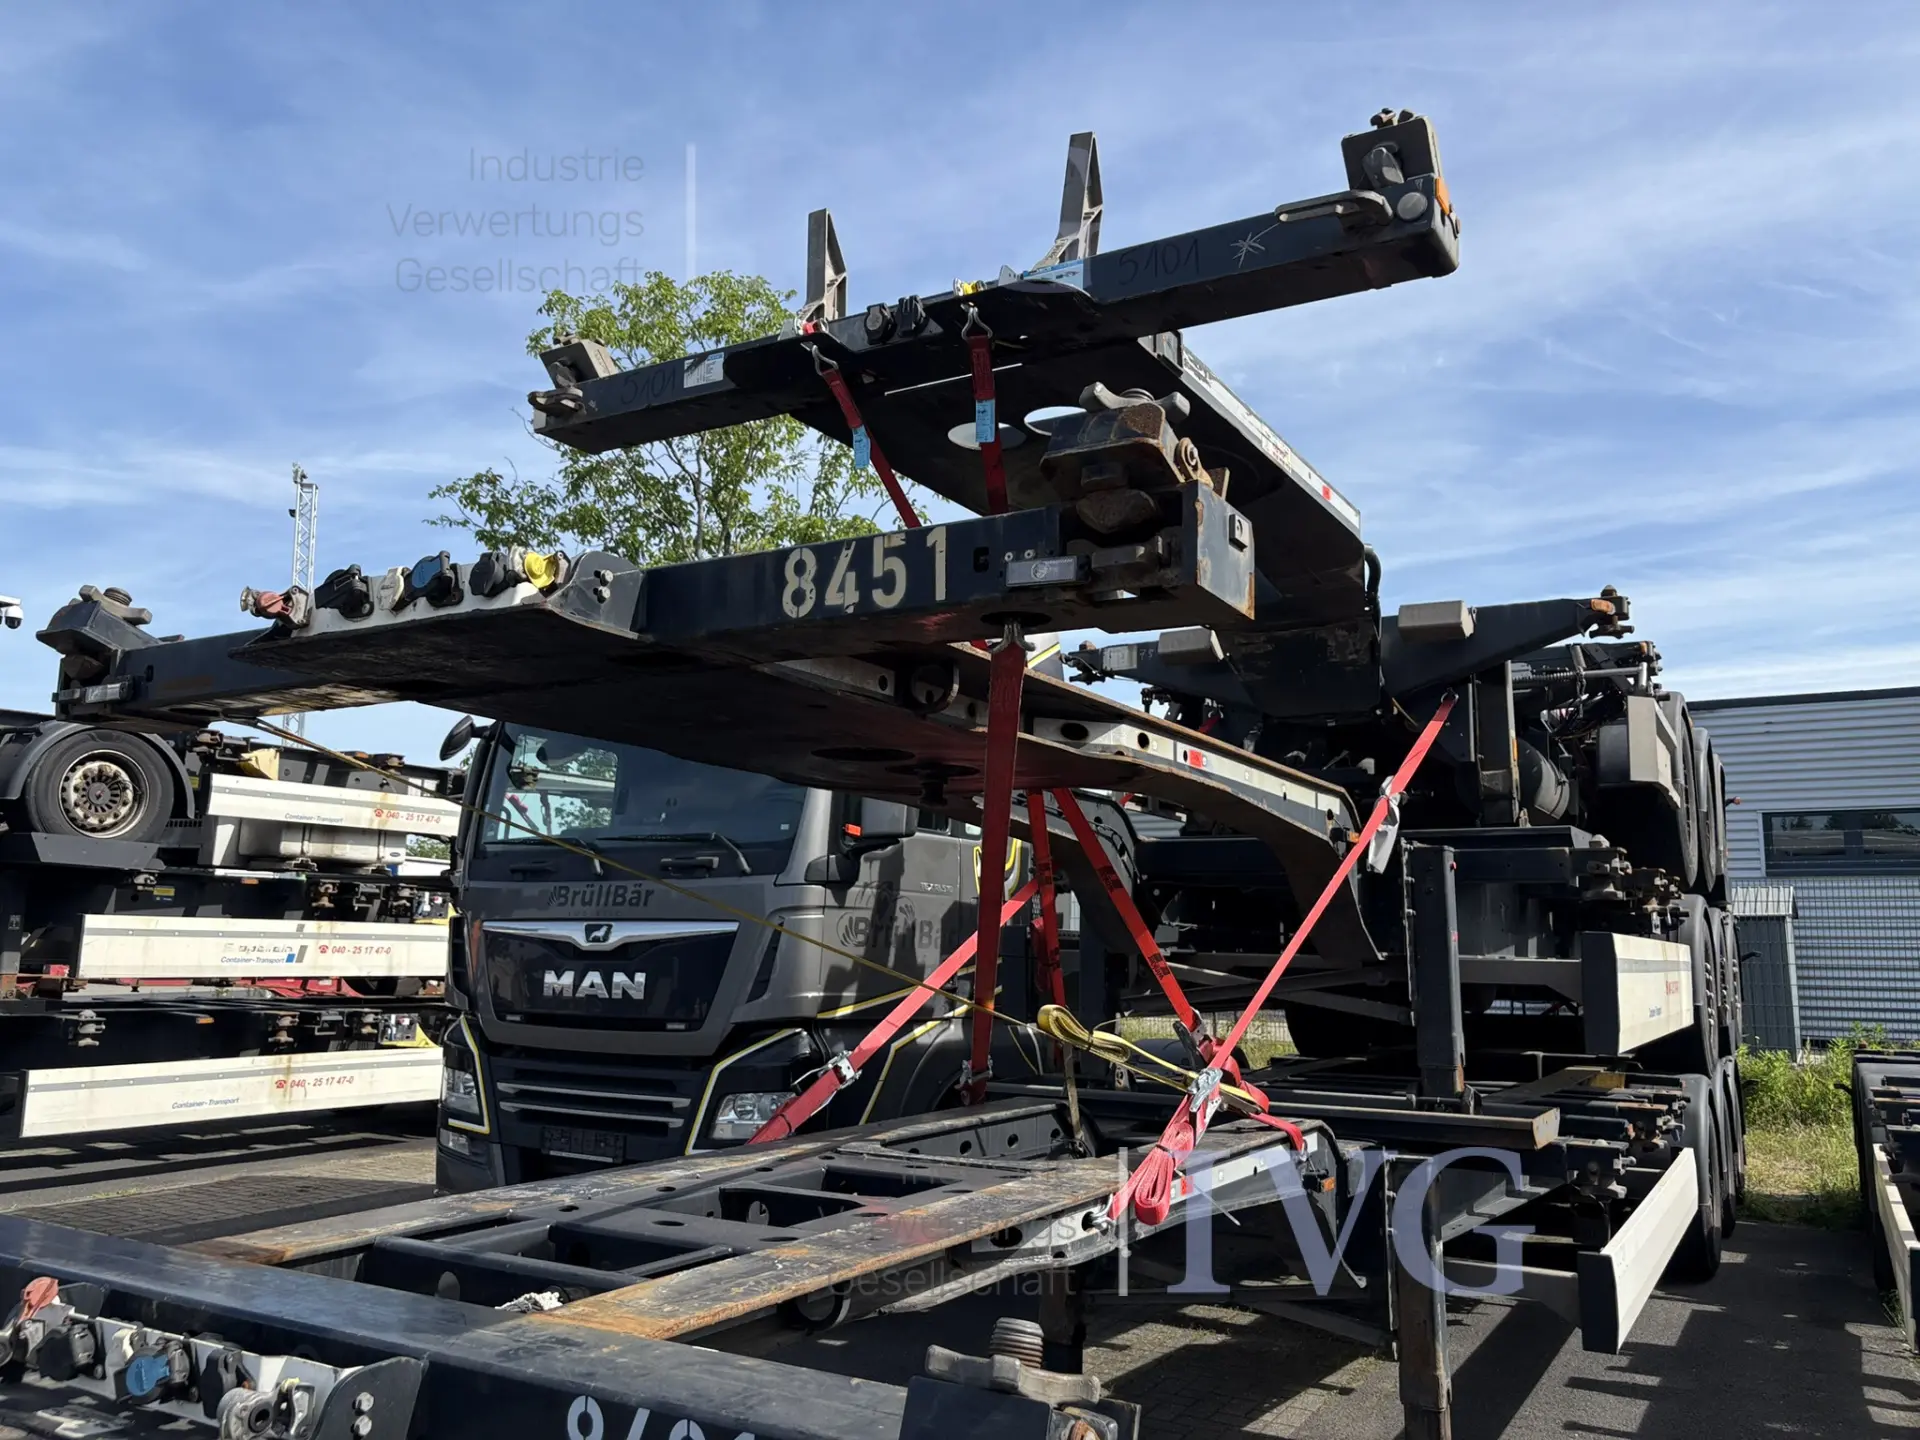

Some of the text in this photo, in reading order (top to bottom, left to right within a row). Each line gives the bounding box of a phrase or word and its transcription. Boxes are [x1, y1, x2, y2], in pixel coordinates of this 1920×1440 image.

[1118, 238, 1200, 286] 5101
[782, 525, 947, 619] 8451
[284, 812, 344, 824] Container-Transport
[386, 810, 400, 820] 040
[406, 812, 415, 822] 25
[416, 813, 424, 823] 17
[426, 814, 441, 824] 47-0
[556, 883, 655, 907] BrüllBär
[331, 945, 346, 954] 040
[353, 945, 363, 955] 25
[364, 945, 374, 955] 17
[375, 945, 392, 955] 47-0
[220, 955, 285, 965] Container-Transport
[543, 969, 647, 1000] MAN
[290, 1078, 305, 1089] 040
[312, 1077, 323, 1087] 25
[324, 1077, 335, 1086] 17
[336, 1075, 354, 1085] 47-0
[171, 1096, 240, 1109] Container-Transport
